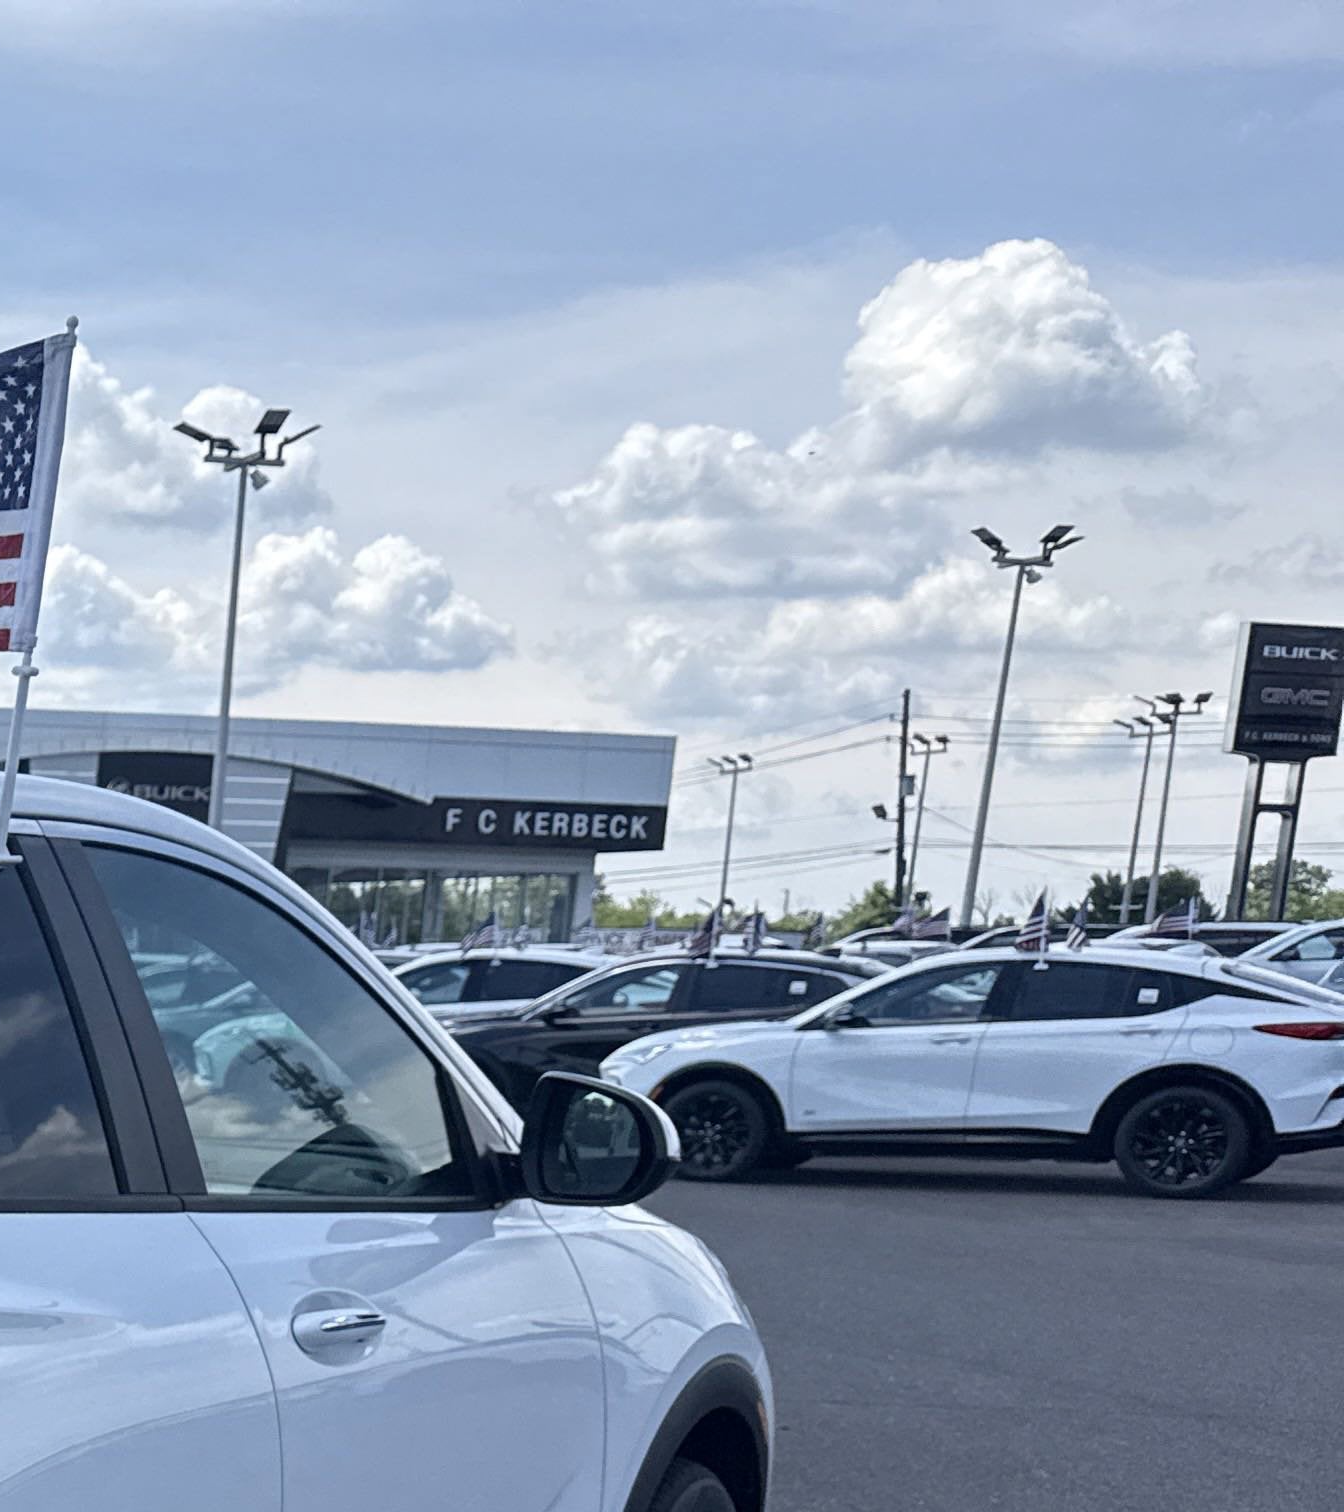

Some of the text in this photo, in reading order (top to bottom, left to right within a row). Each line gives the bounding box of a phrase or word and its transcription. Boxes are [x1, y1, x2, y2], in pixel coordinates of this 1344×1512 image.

[1263, 645, 1339, 660] BUICK
[1261, 687, 1330, 706] GMC
[133, 784, 211, 800] BUICK
[445, 808, 649, 840] F C KERBECK
